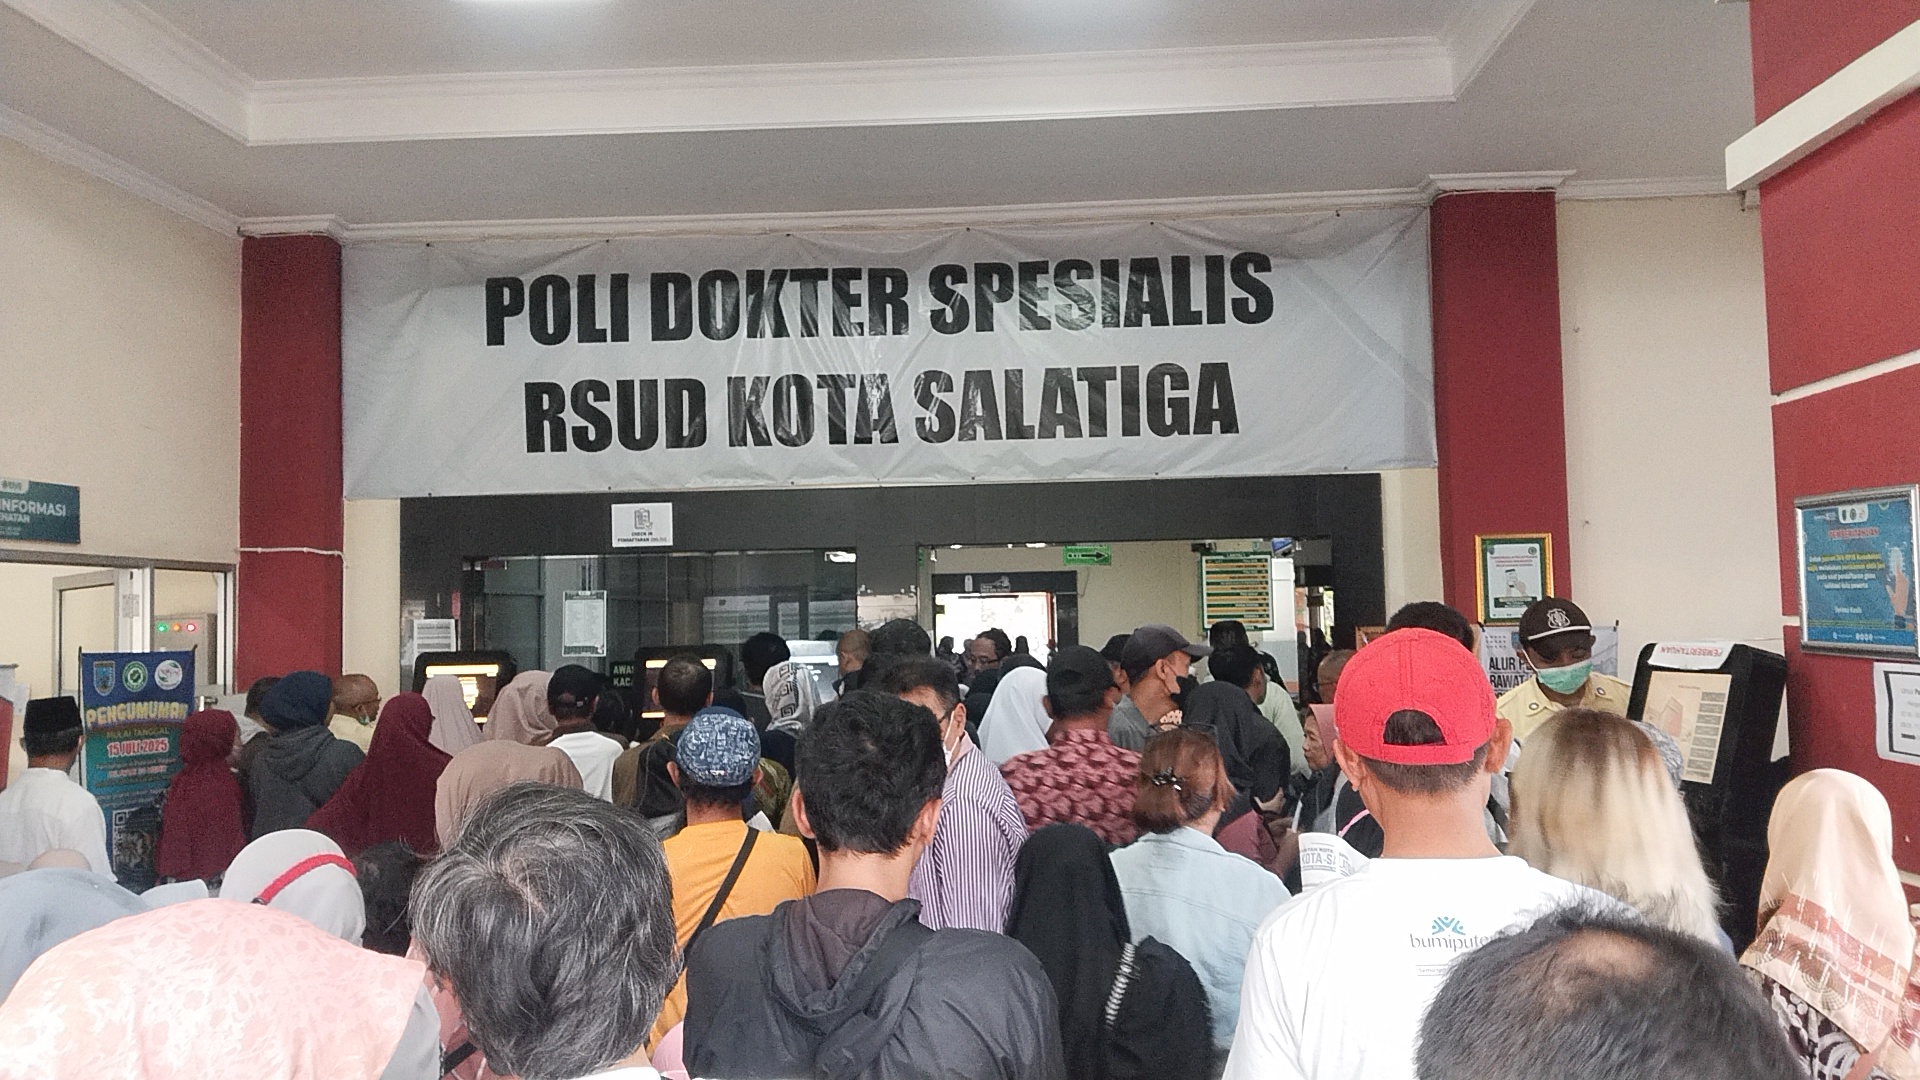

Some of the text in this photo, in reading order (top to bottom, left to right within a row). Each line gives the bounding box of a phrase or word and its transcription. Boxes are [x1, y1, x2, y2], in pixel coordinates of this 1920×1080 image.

[485, 252, 1274, 346] POLI DOKTER SPESIALIS
[524, 362, 1239, 453] RSUD KOTA SALATIGA
[1489, 657, 1516, 671] ALUR
[613, 677, 633, 687] KAC
[86, 701, 188, 728] PENGUMUMAN
[107, 738, 169, 757] 15 JULI 2025
[1410, 933, 1490, 953] bumipute
